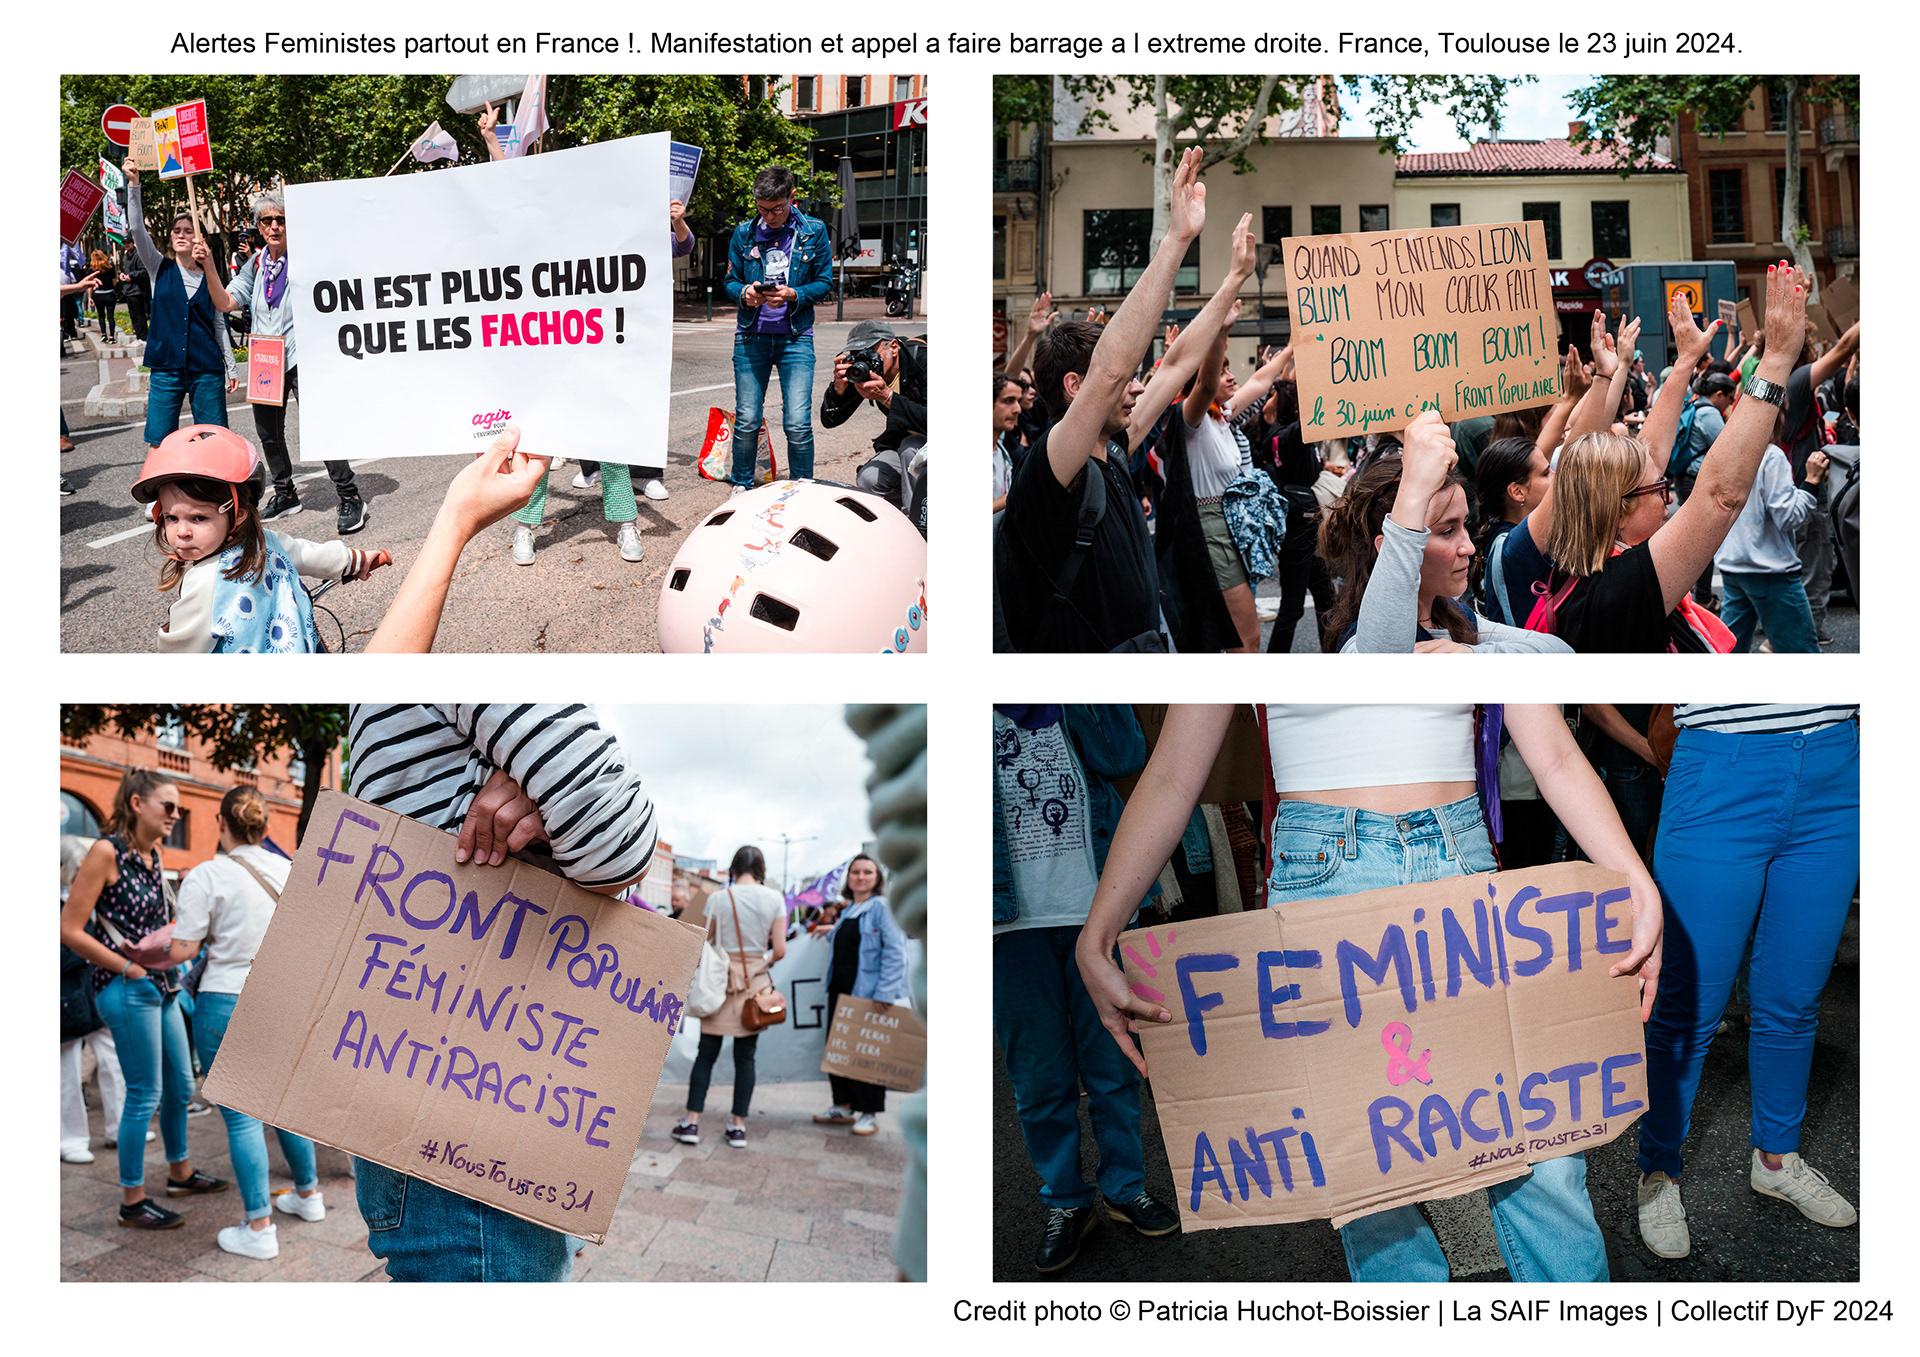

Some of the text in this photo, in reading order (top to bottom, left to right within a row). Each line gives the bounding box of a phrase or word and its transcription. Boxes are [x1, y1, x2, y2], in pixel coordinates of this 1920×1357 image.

[62, 186, 88, 208] ÉGALITÉ
[68, 176, 94, 198] LIBERTÉ
[858, 249, 875, 258] FC
[1294, 224, 1532, 284] QUAND J'ENTENDS LEON
[312, 254, 647, 314] ON EST PLUS CHAUD
[1297, 284, 1350, 326] BLUM
[1376, 278, 1425, 320] MON
[1506, 268, 1538, 312] FAIT
[1556, 300, 1584, 311] Rapide
[338, 307, 626, 360] QUE LES FACHOS !
[1331, 337, 1387, 384] BOOM
[1414, 331, 1458, 372] BOOM
[472, 408, 512, 430] agir
[1307, 396, 1326, 426] le
[1336, 399, 1356, 428] 30
[1358, 404, 1396, 431] juin
[1455, 373, 1494, 412] FRONT
[317, 808, 548, 960] FRONT
[836, 1022, 892, 1044] TU FERAS
[838, 1006, 900, 1029] JE FERAI
[856, 1042, 880, 1057] FERA
[1381, 1021, 1433, 1086] &
